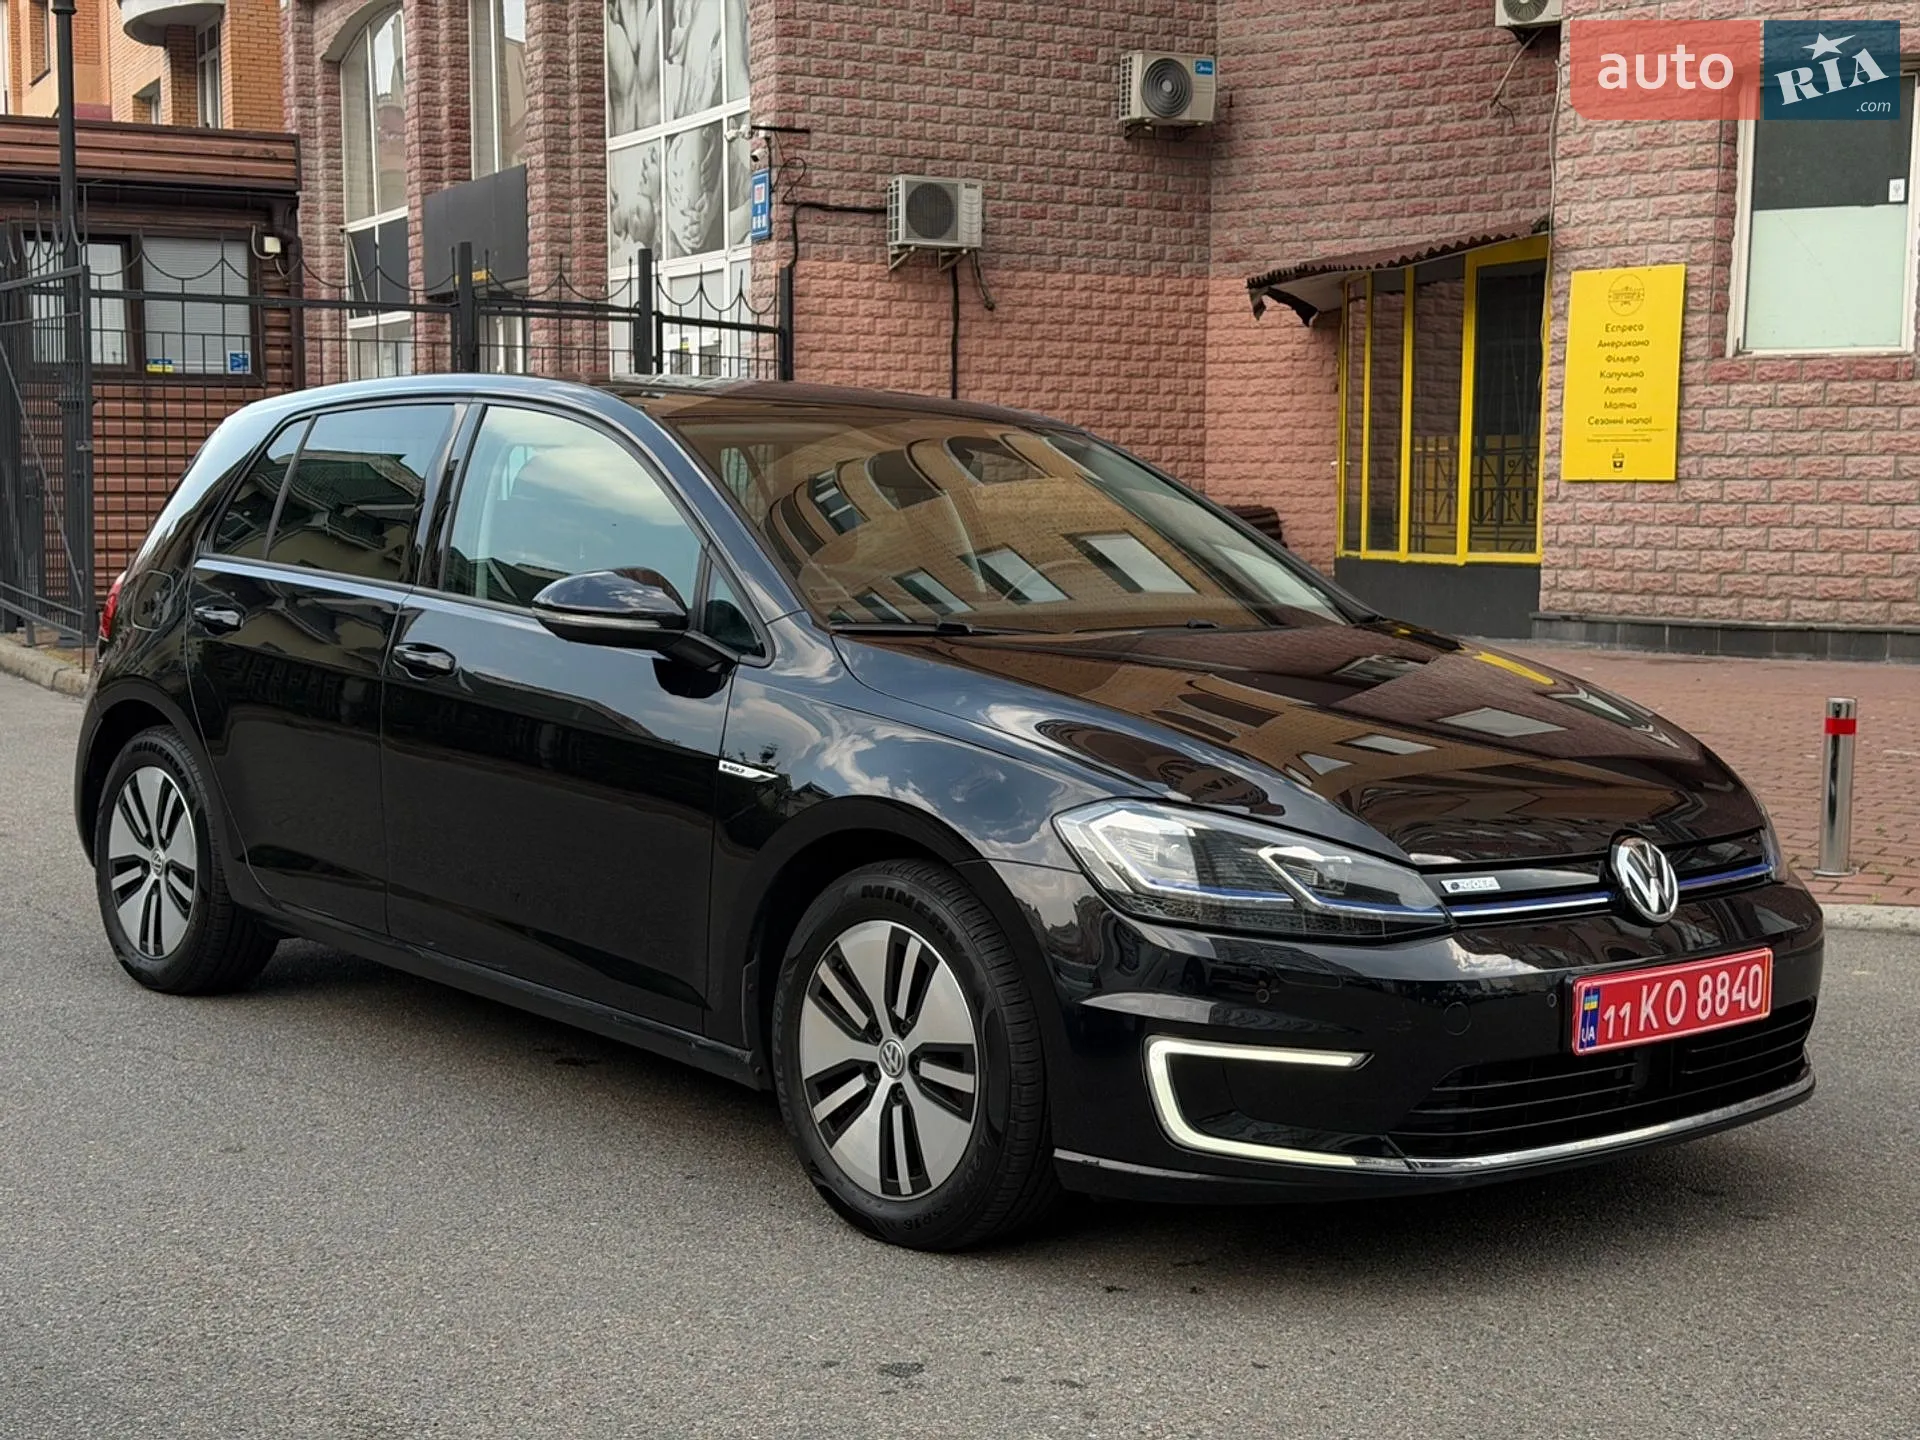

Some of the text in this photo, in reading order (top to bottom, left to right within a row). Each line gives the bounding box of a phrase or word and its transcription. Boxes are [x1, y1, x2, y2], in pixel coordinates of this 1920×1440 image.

[1605, 323, 1645, 333] Еспресо
[1597, 339, 1650, 349] Американо
[1605, 354, 1641, 364] Фільтр
[1604, 386, 1638, 394] Латте
[1603, 401, 1637, 410] Матча
[1696, 963, 1763, 1021] 8840
[1581, 1025, 1596, 1043] UA
